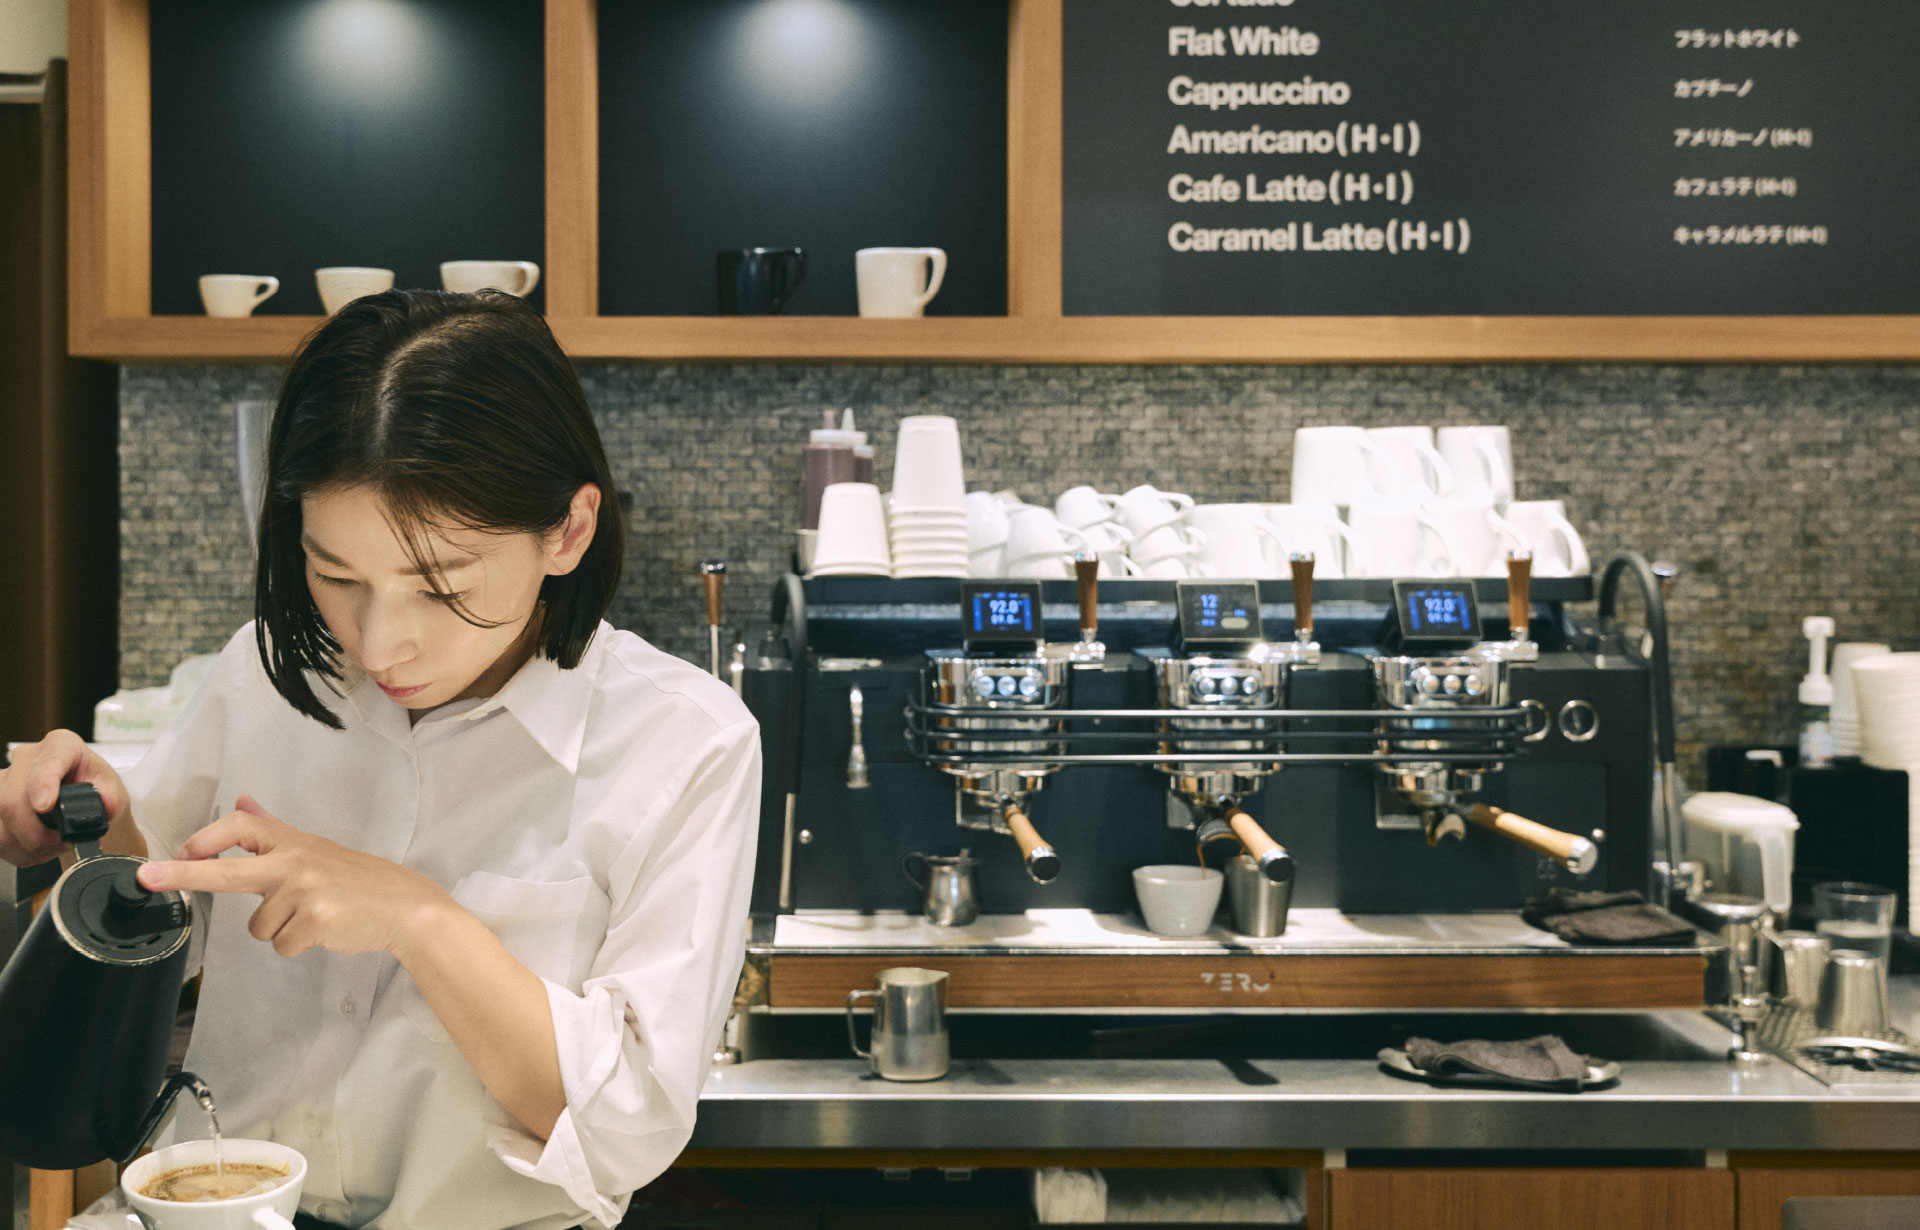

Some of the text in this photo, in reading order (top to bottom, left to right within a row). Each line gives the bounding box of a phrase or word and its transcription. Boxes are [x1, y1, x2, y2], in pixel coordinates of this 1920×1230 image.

[1168, 26, 1320, 56] Flat White
[1167, 75, 1351, 111] Cappuccino
[1167, 173, 1241, 202] Cafe
[1167, 221, 1298, 251] Caramel
